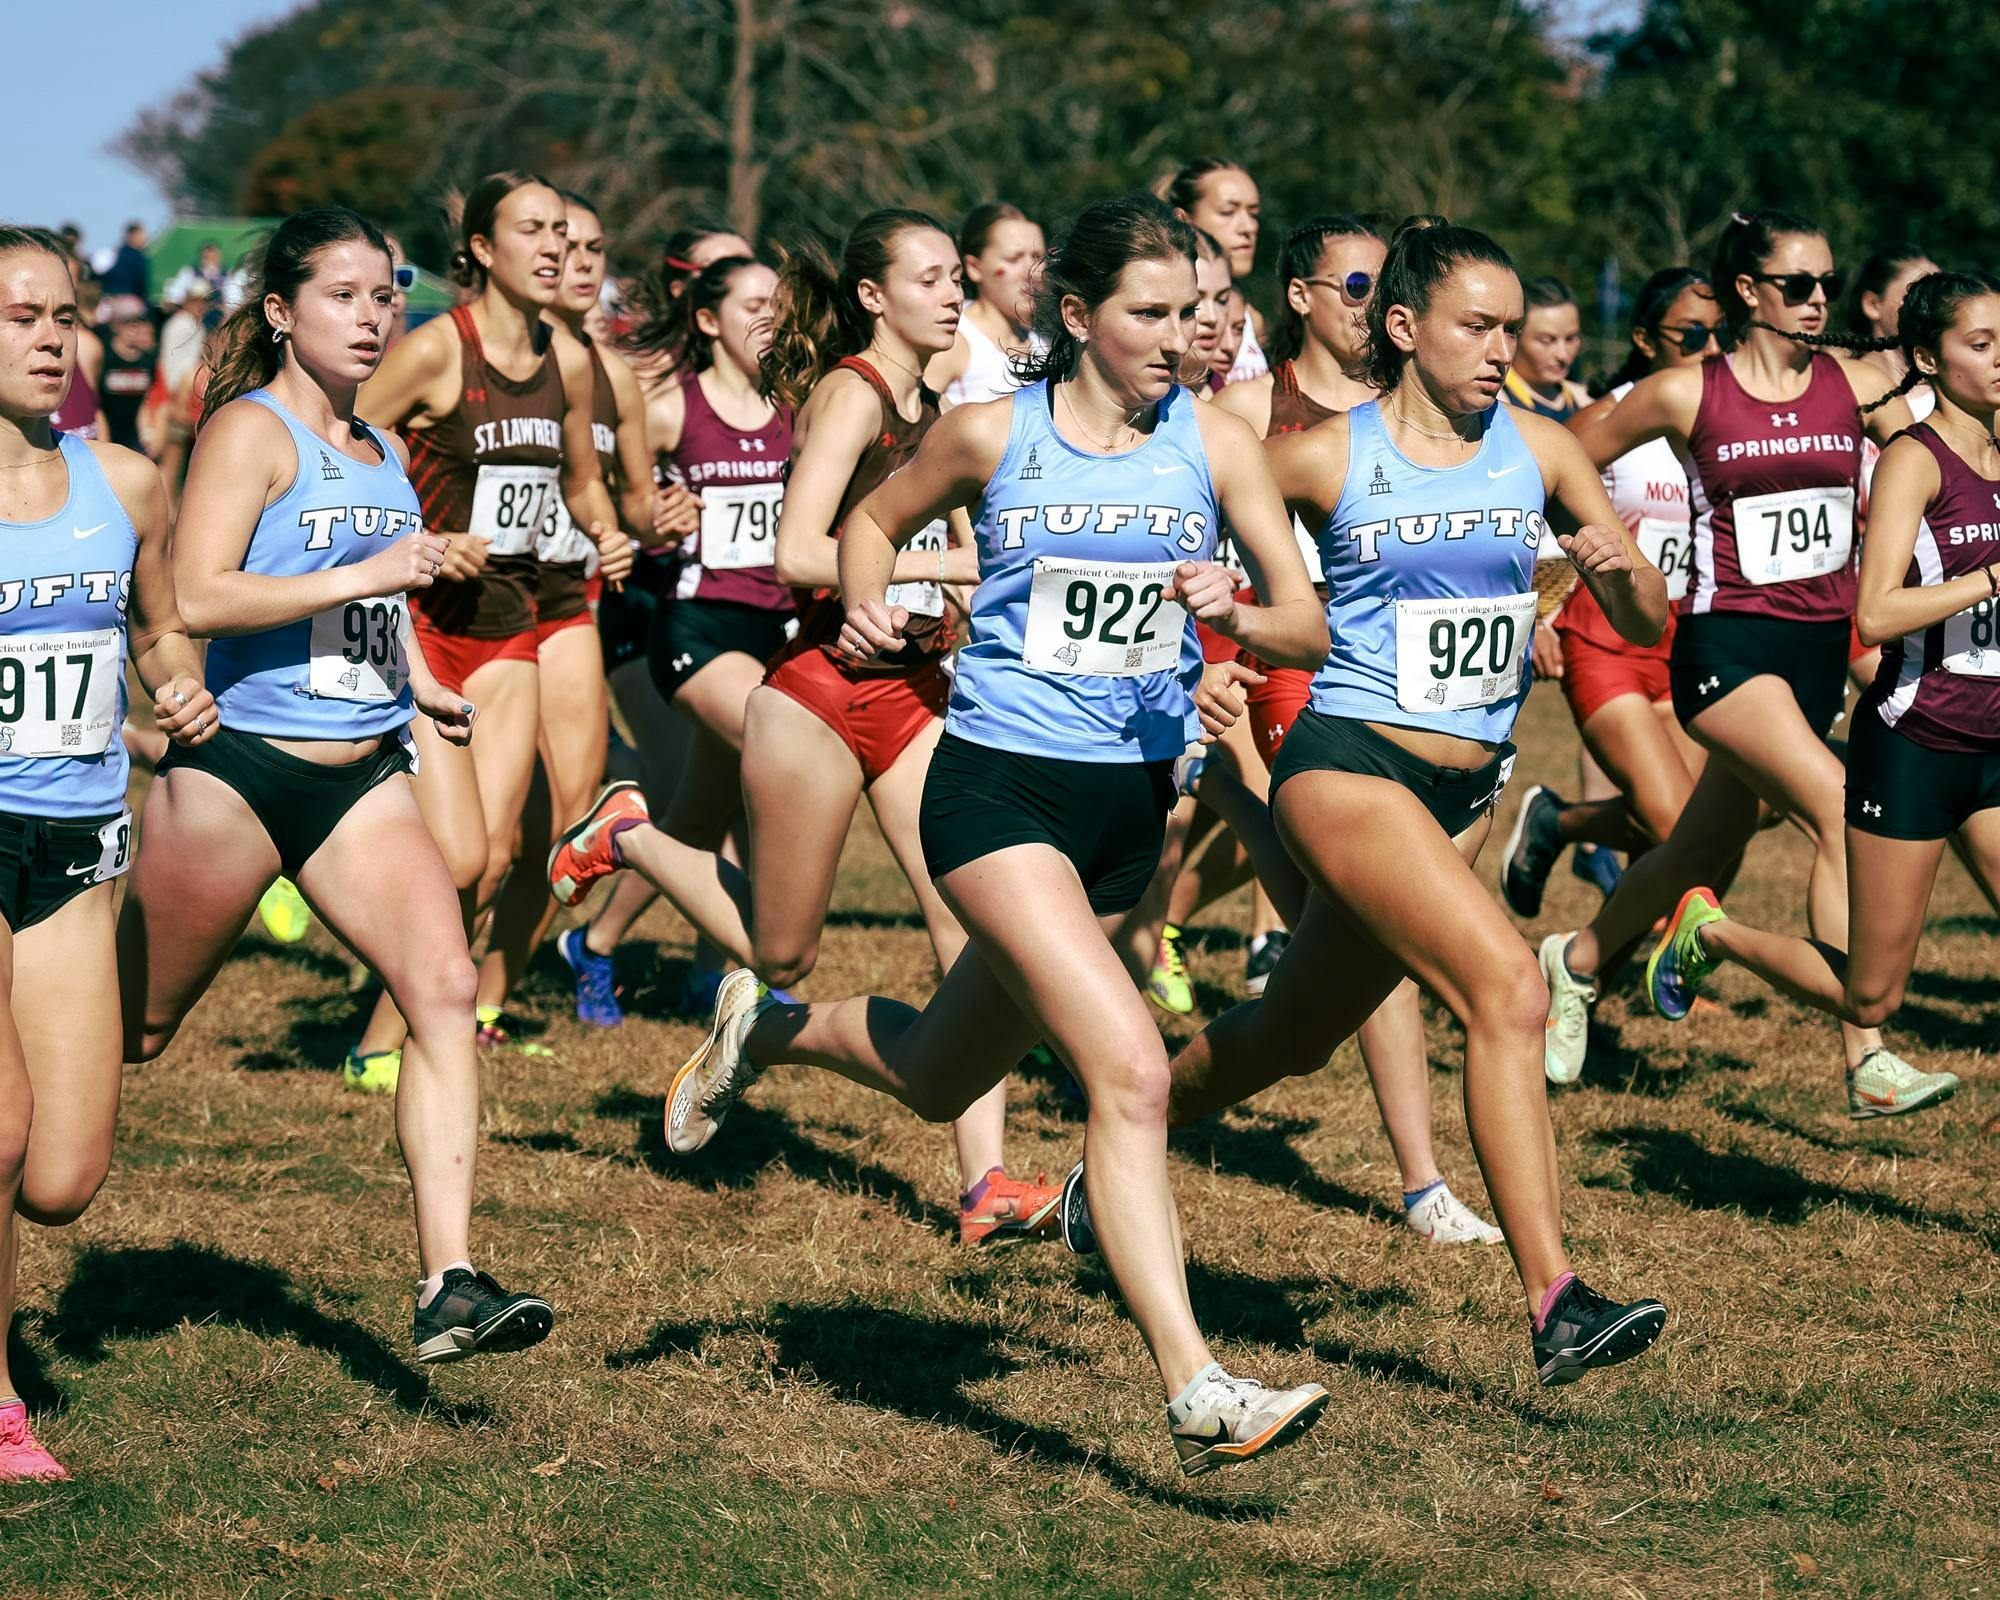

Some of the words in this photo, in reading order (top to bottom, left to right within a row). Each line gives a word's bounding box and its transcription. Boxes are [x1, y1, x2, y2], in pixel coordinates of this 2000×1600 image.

[474, 421, 502, 454] ST.
[1717, 434, 1854, 462] SPRINGFIELD
[497, 483, 547, 528] 827
[1645, 480, 1689, 503] MON
[728, 501, 783, 543] 798
[997, 504, 1207, 553] TUFTS
[1348, 508, 1542, 564] TUFTS
[1761, 504, 1832, 556] 794
[1949, 523, 2000, 546] SPRI
[1043, 564, 1101, 578] Connecticut
[1105, 569, 1140, 581] College
[1063, 580, 1164, 645] 922
[1404, 607, 1457, 616] Connecticut
[1461, 604, 1492, 615] College
[1494, 600, 1536, 612] Invitational
[29, 642, 64, 652] College
[67, 637, 111, 650] Invitational
[1429, 615, 1515, 679] 920
[0, 653, 93, 724] 917
